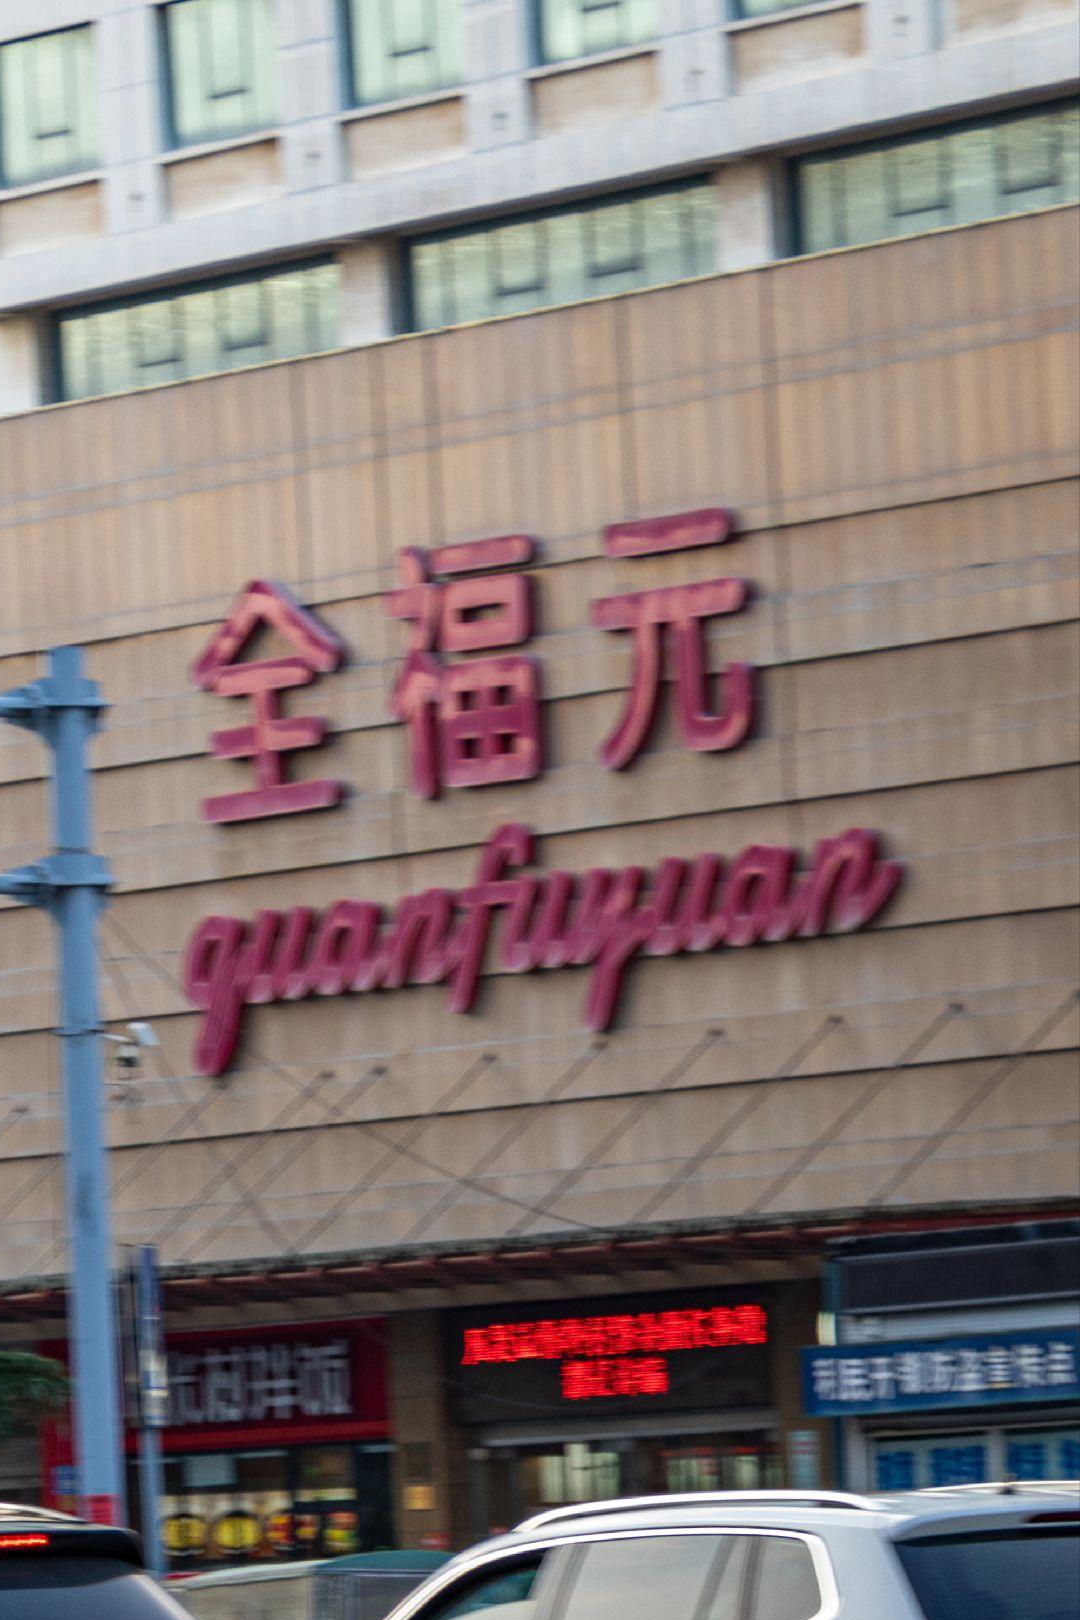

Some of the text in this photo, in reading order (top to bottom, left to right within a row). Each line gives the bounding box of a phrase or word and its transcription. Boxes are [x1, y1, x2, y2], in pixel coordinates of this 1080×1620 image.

[190, 506, 757, 824] 全福元
[184, 822, 904, 1076] quanfuyuan
